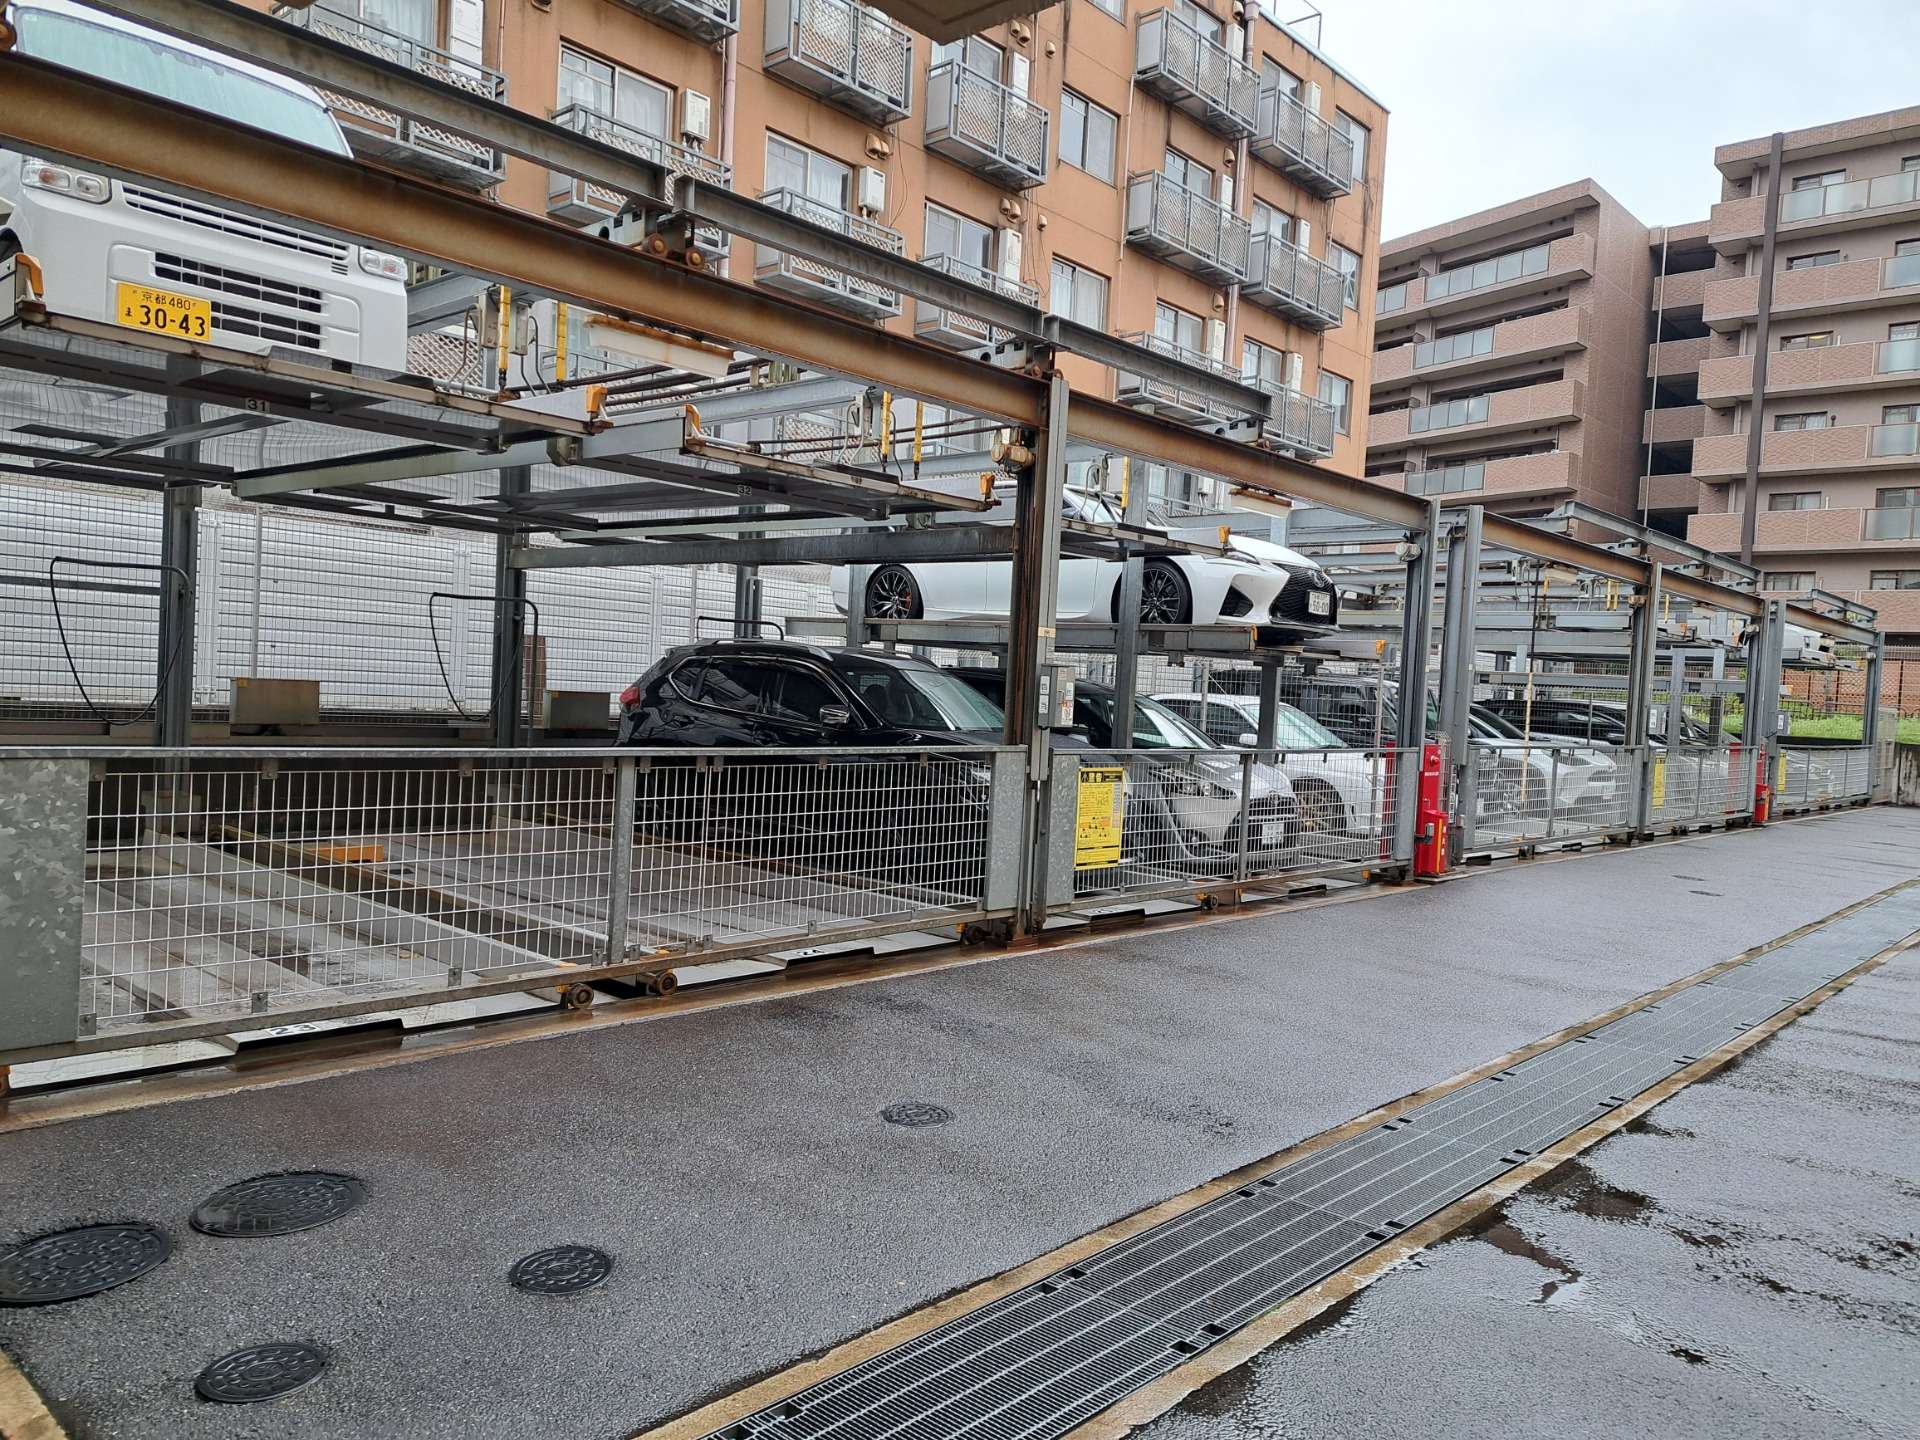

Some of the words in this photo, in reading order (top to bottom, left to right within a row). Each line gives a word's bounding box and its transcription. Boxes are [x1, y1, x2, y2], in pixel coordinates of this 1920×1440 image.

[139, 304, 206, 337] 30-43
[247, 399, 266, 412] 31
[269, 1023, 317, 1035] 23
